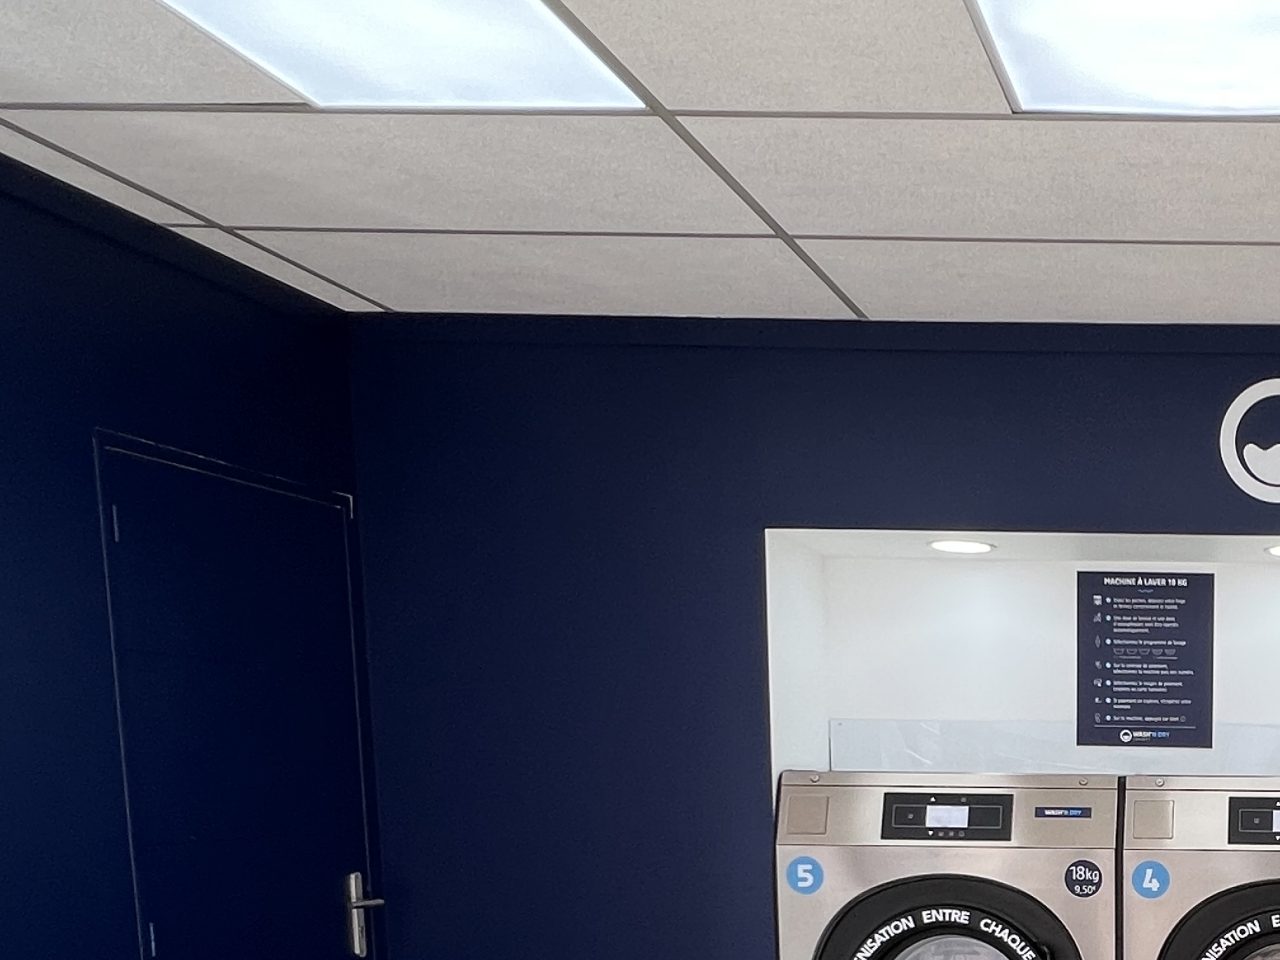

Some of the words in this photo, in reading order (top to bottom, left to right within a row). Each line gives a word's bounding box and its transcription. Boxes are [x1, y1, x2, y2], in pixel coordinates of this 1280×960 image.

[1144, 578, 1166, 586] LAVER
[796, 866, 815, 887] 5
[1069, 866, 1100, 883] 18kg
[1141, 868, 1161, 891] 4
[921, 909, 971, 924] ENTRE
